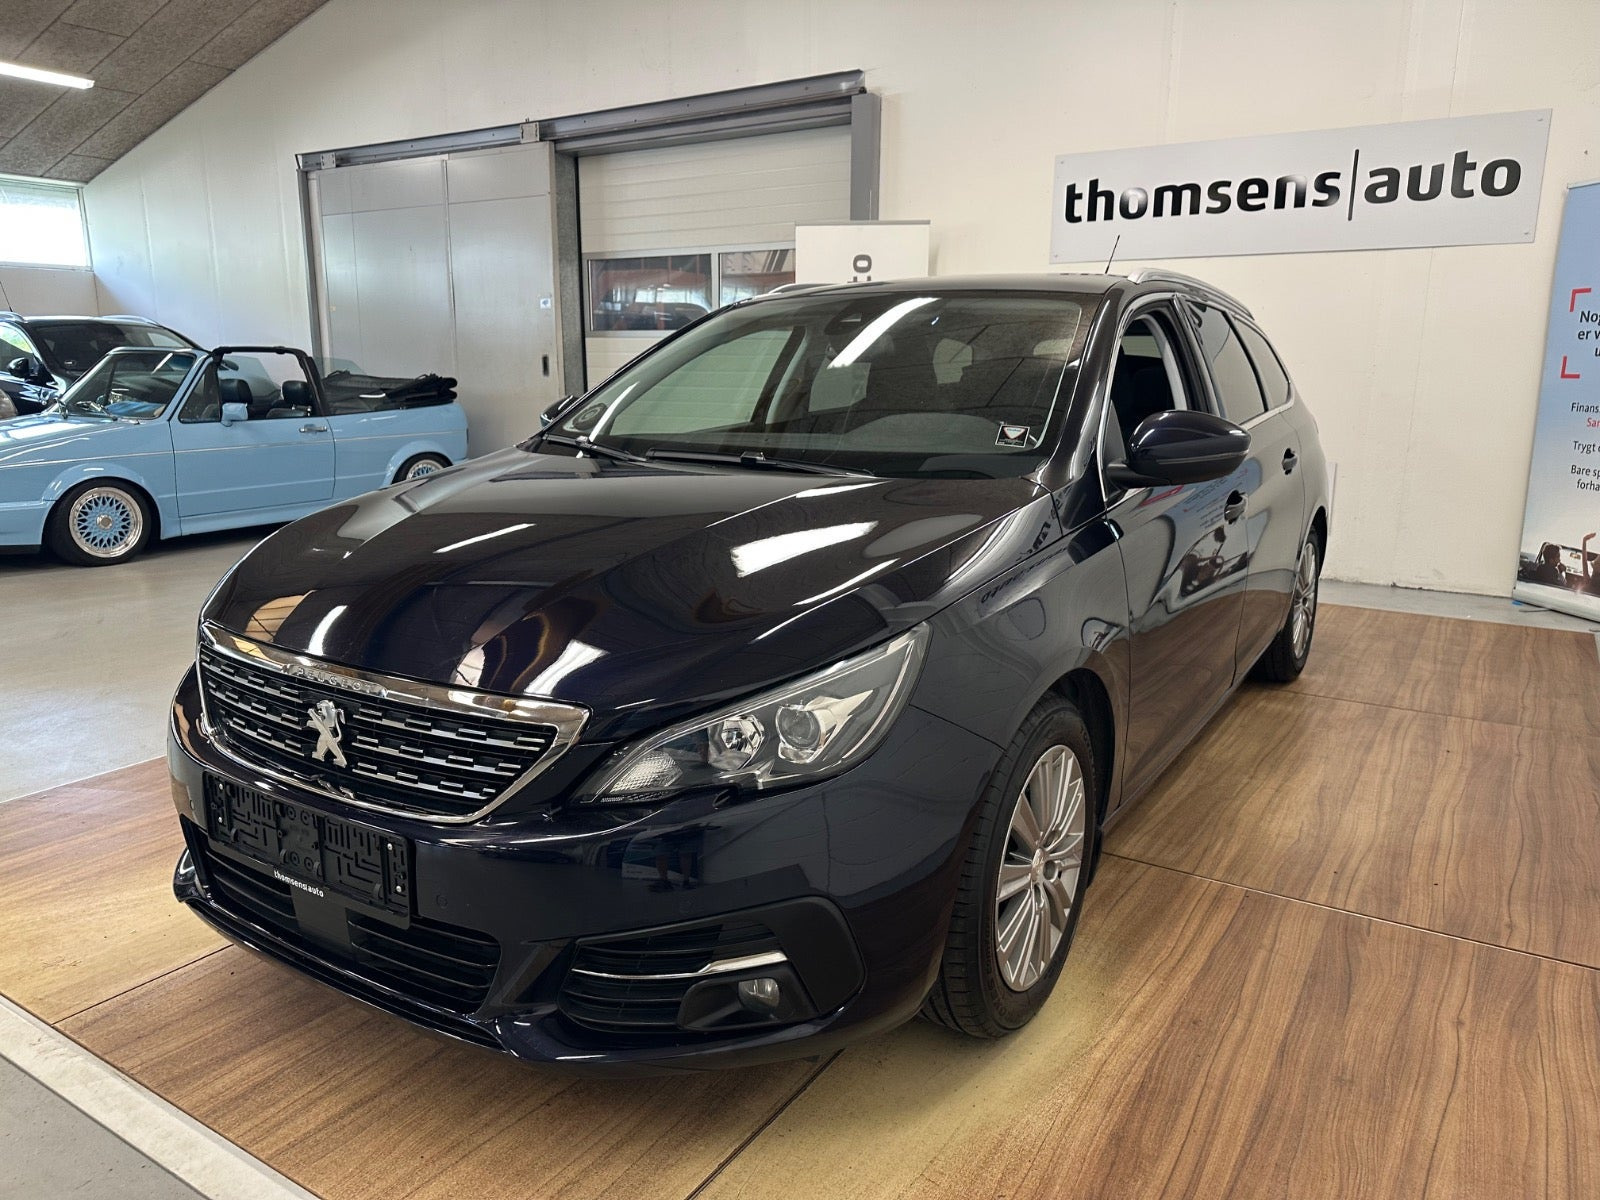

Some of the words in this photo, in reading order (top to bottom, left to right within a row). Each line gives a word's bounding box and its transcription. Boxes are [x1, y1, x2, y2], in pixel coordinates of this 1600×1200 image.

[1577, 329, 1592, 341] er
[1573, 440, 1596, 455] Trygt
[1570, 464, 1591, 477] Bare
[296, 666, 372, 694] PEUGEOT
